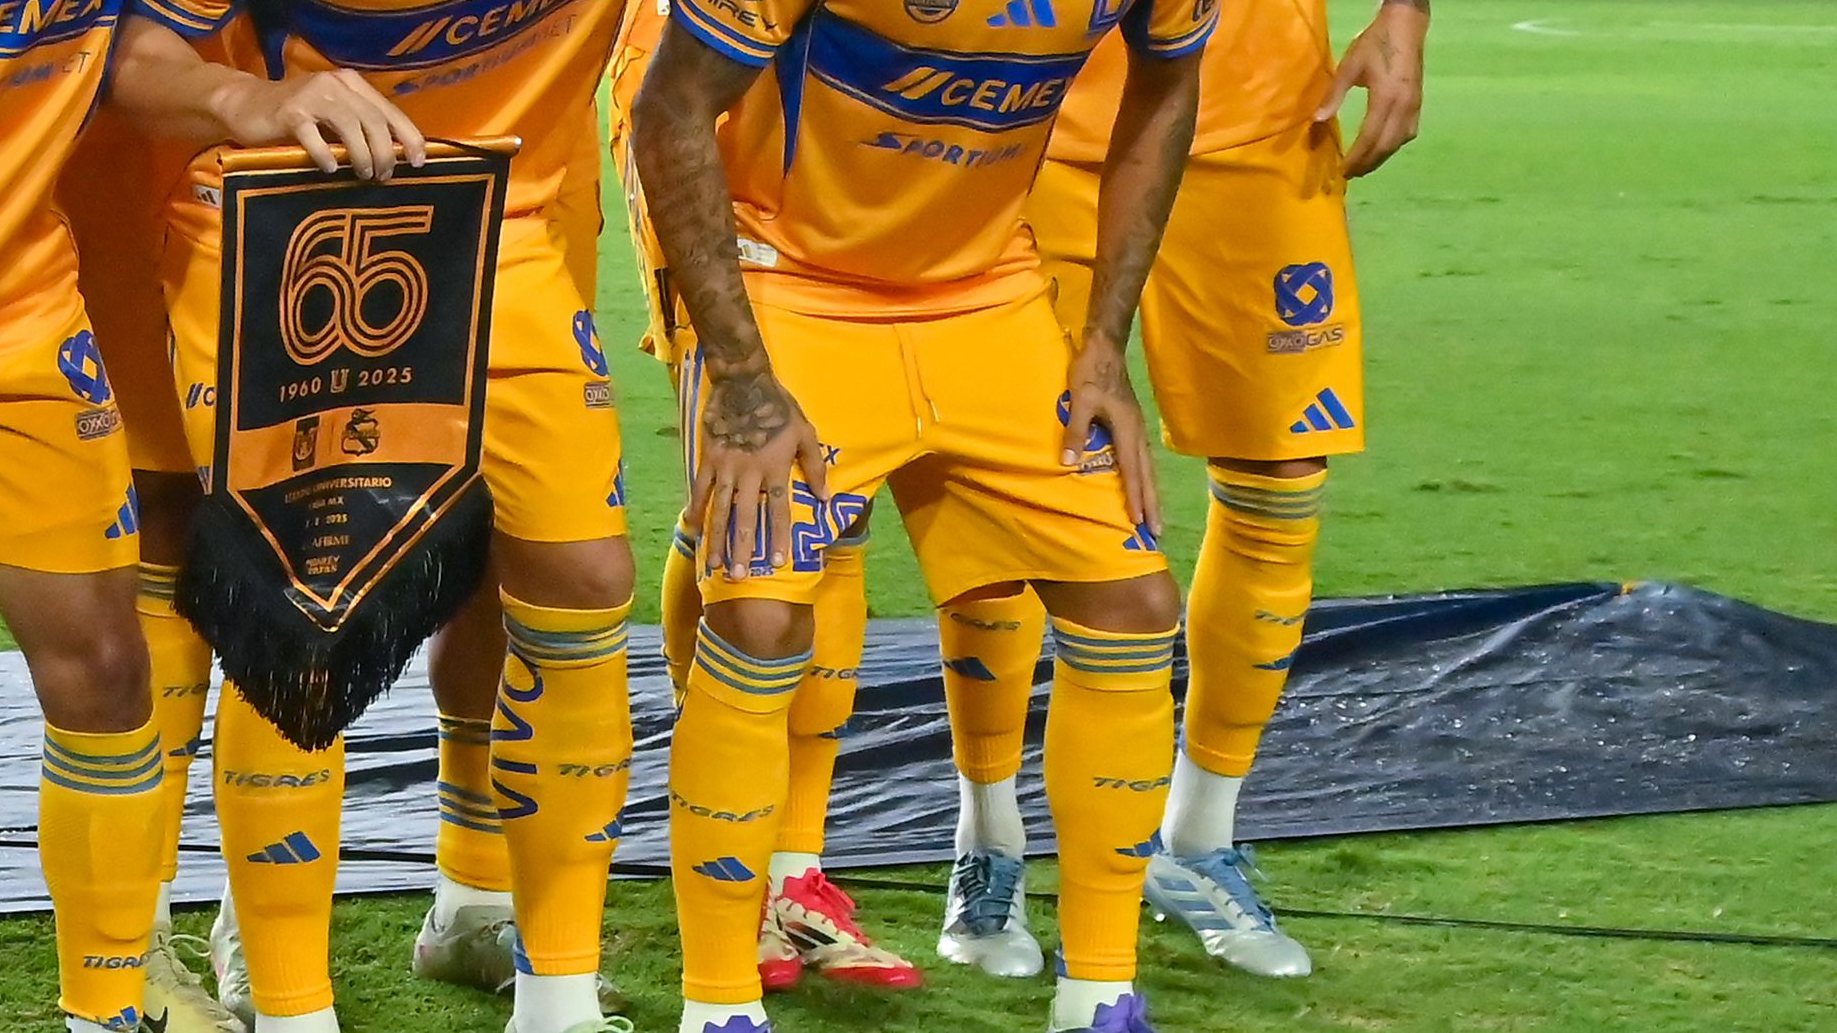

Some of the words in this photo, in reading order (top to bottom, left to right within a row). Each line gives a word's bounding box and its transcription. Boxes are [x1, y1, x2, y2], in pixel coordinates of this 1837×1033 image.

[278, 205, 434, 366] 65
[1306, 327, 1343, 346] GAS
[279, 376, 323, 403] 1960
[358, 366, 413, 387] 2025
[78, 414, 112, 433] OXXO
[223, 768, 331, 788] TIGRES
